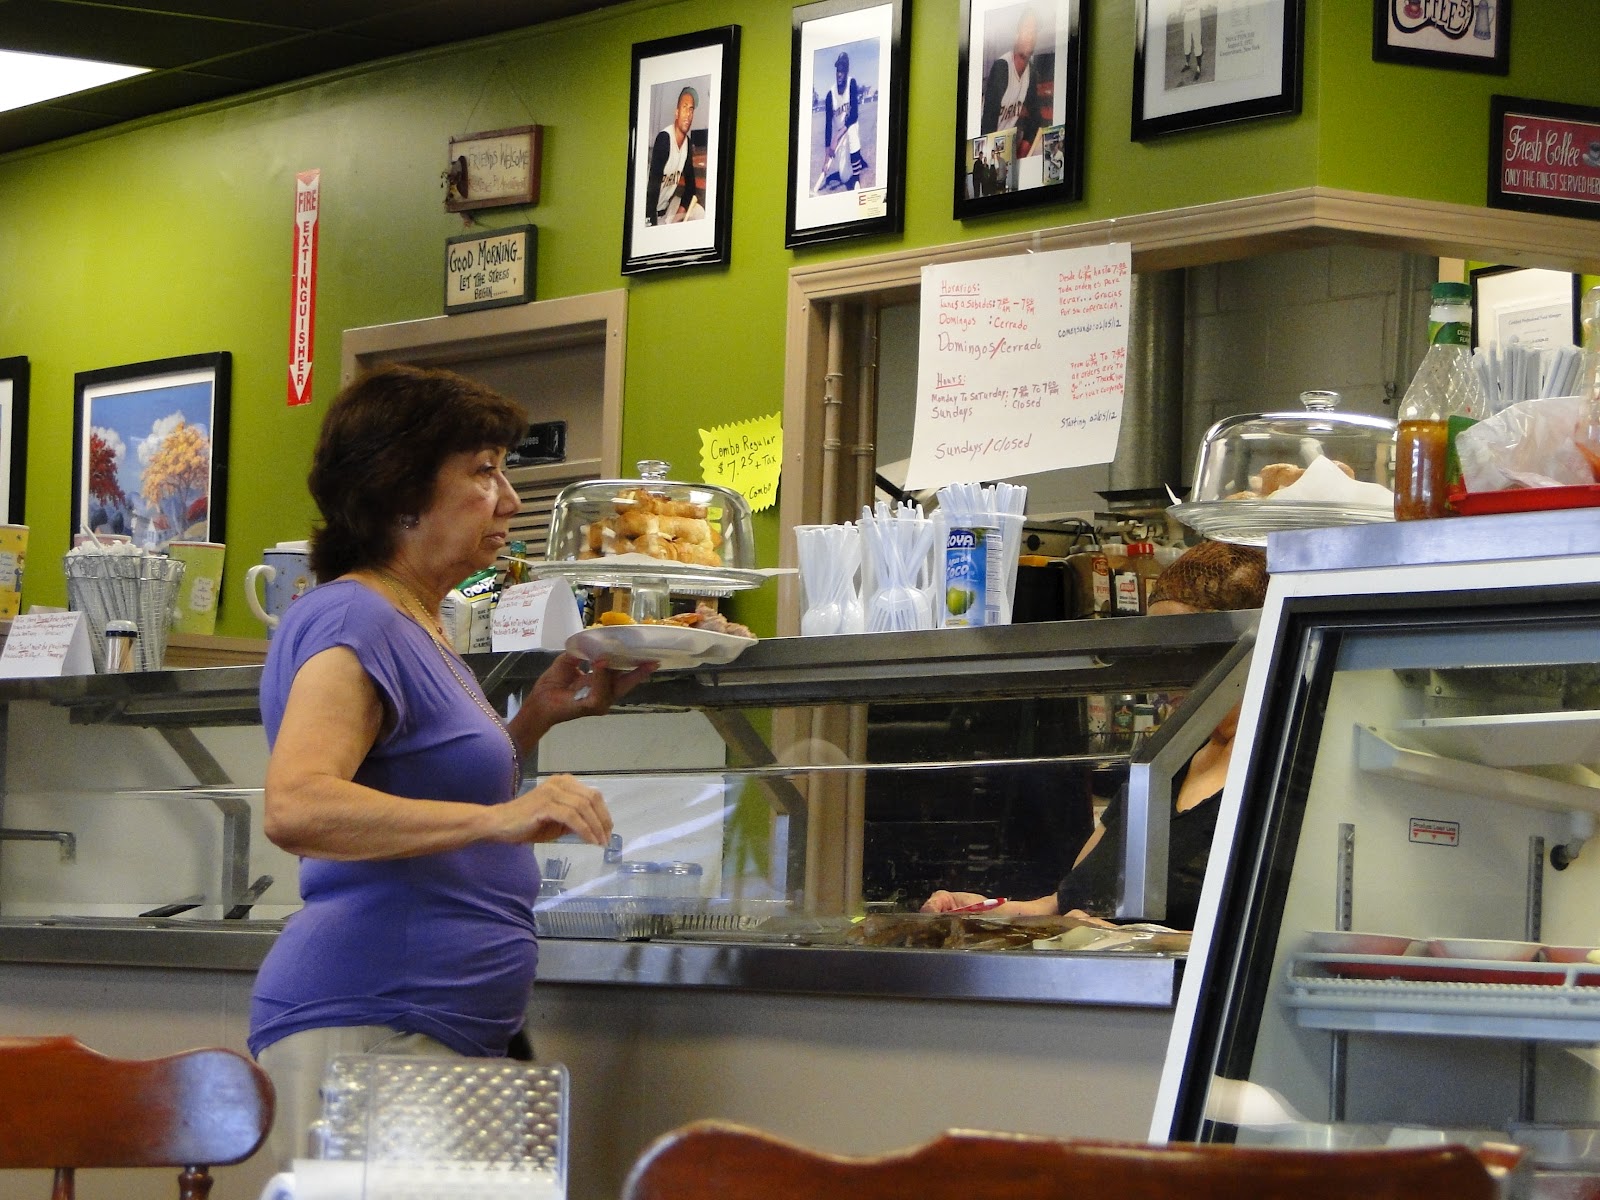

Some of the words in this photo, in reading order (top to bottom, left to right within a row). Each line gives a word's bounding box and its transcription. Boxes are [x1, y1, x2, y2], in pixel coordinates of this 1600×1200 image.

[1505, 125, 1542, 163] Fresh
[1545, 130, 1580, 167] Coffee
[1504, 168, 1521, 187] ONLY
[1522, 169, 1535, 188] THE
[1536, 171, 1558, 190] FINEST
[1559, 173, 1587, 193] SERVED
[298, 189, 317, 213] FIRE
[449, 248, 473, 273] GOOD
[460, 274, 471, 291] LET
[473, 272, 485, 287] THE
[489, 268, 509, 283] STRESS
[1075, 283, 1092, 291] orden
[1094, 281, 1101, 289] es
[296, 220, 310, 386] EXTINGUISHER
[940, 298, 958, 310] Lunes
[1094, 290, 1122, 300] Gracias
[939, 313, 976, 332] Domingos
[931, 393, 958, 405] Monday
[931, 406, 973, 423] Sundays
[1012, 396, 1041, 409] Closed
[711, 438, 740, 460] Combo
[742, 435, 776, 452] Regular
[761, 454, 777, 465] Tax
[749, 482, 772, 500] Combo
